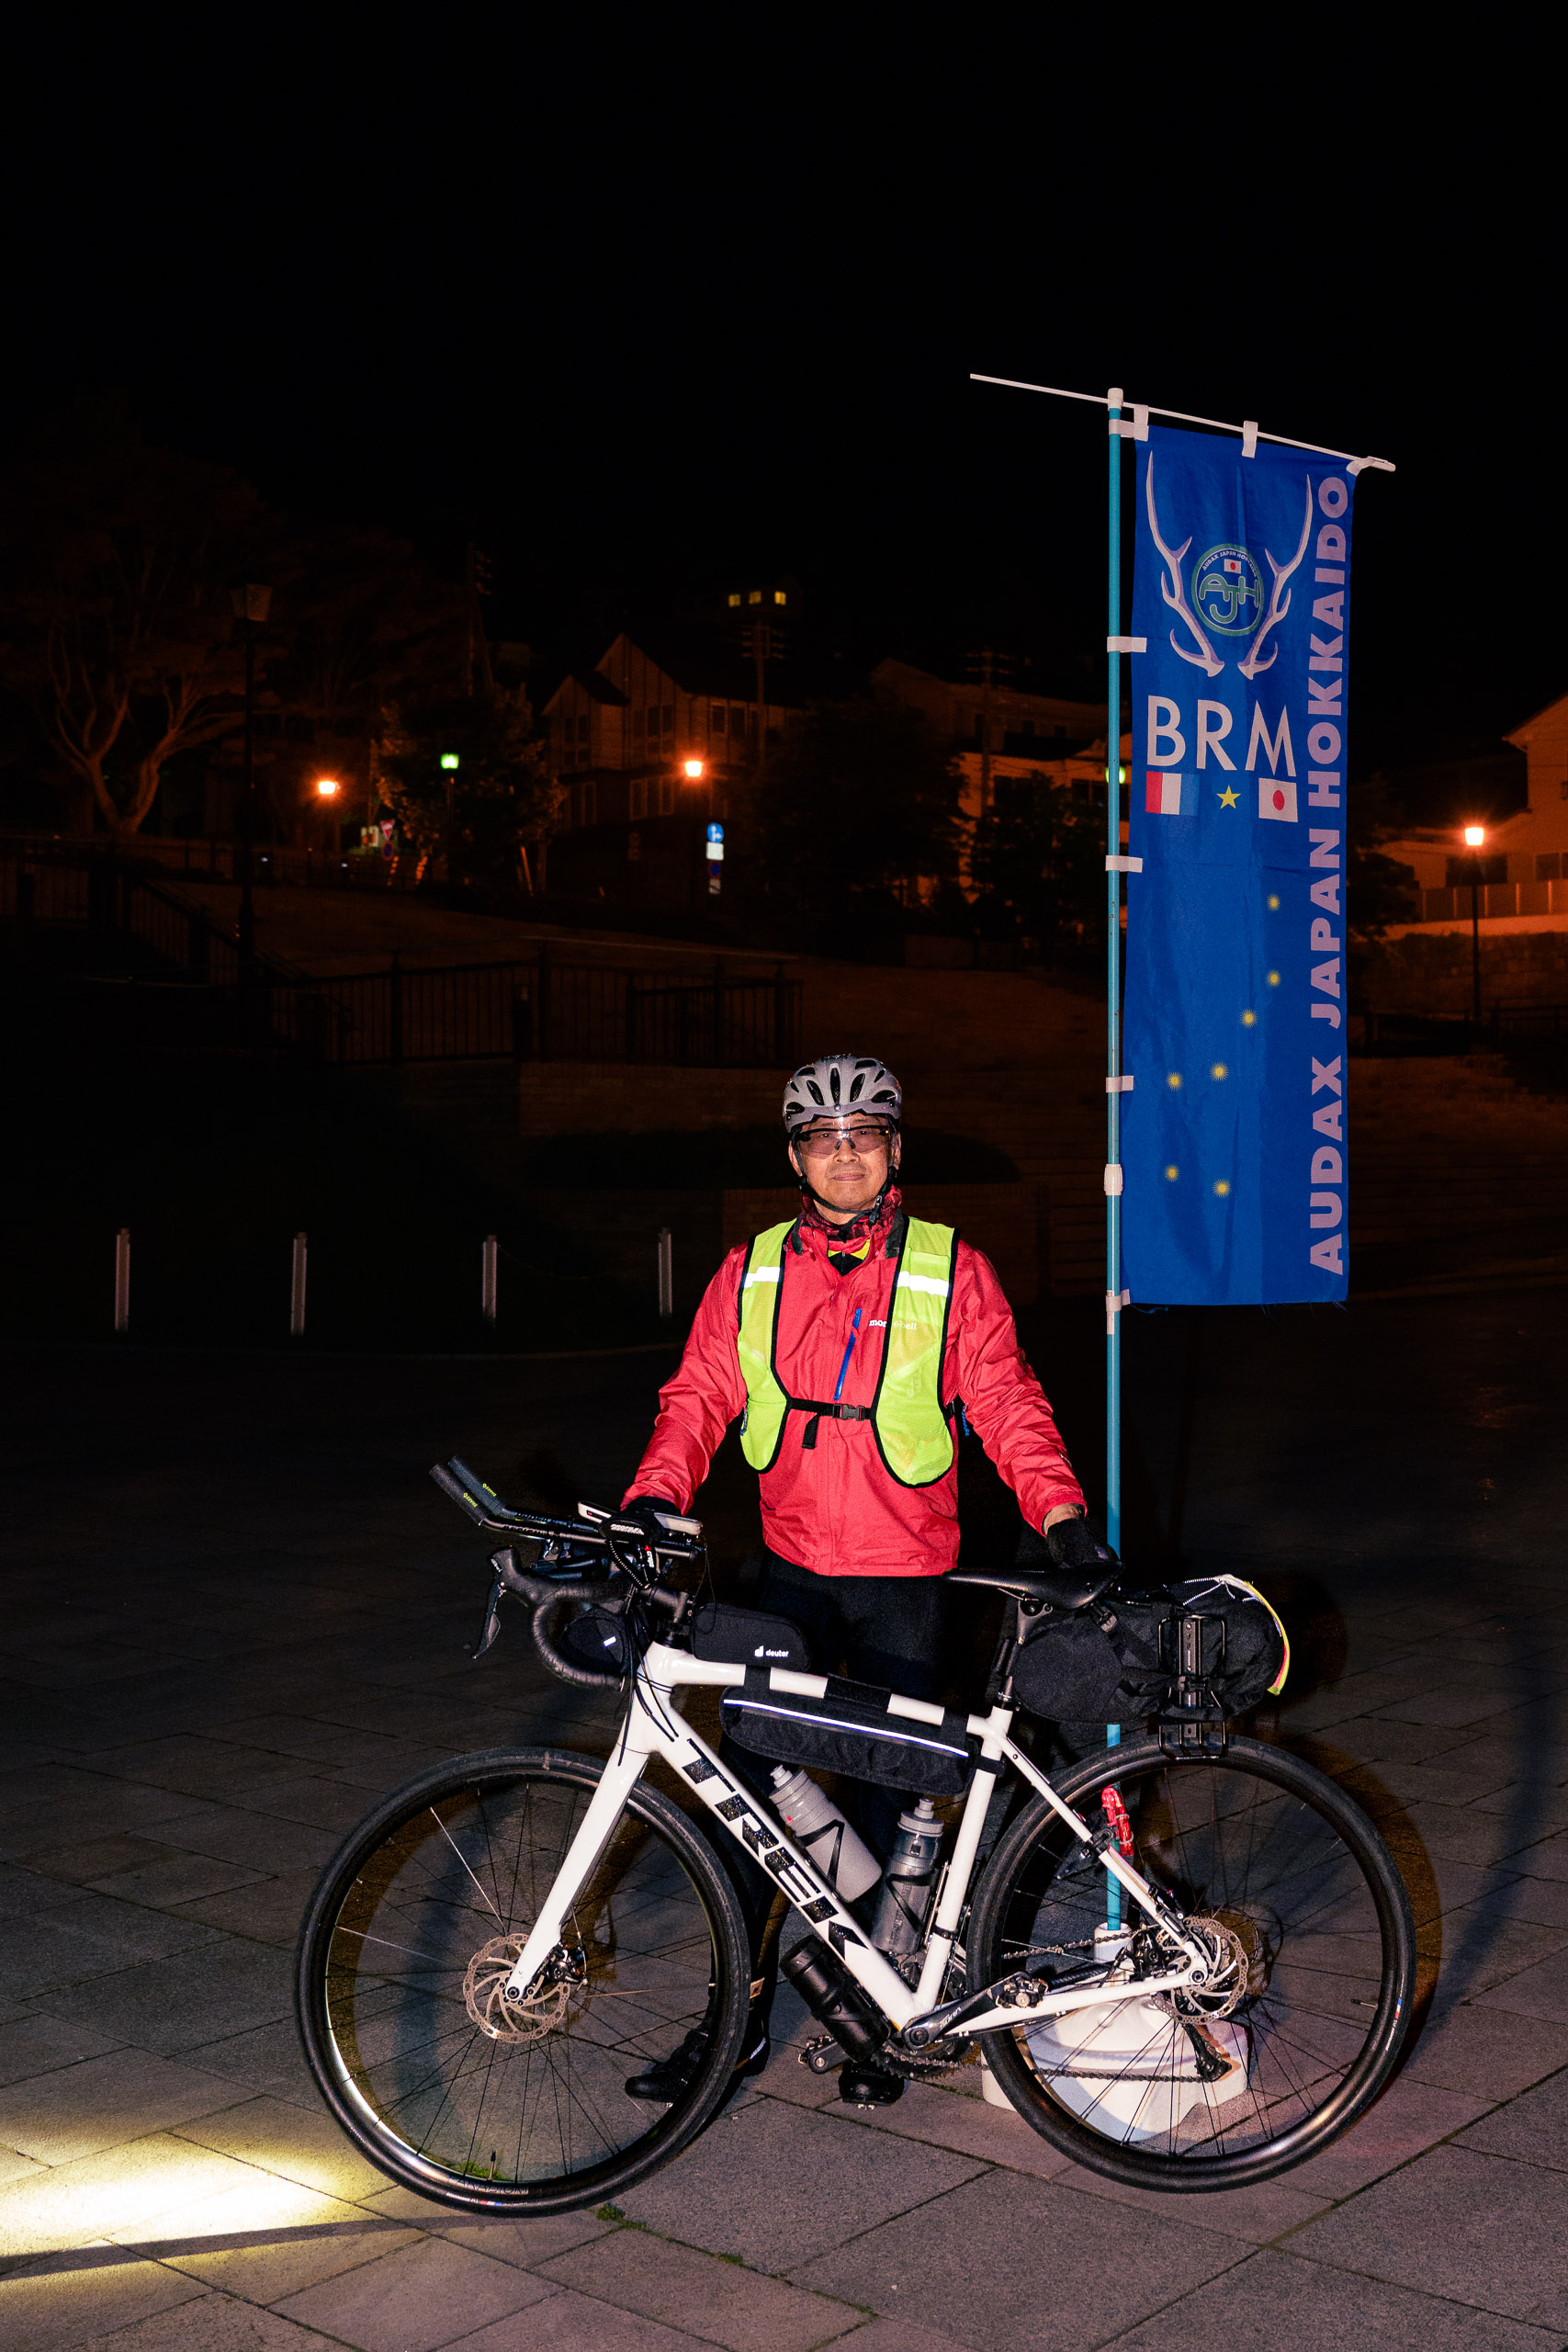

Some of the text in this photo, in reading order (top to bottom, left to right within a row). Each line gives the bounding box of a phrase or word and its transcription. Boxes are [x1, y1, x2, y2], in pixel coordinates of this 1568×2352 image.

[1202, 553, 1219, 571] AUDAX
[1146, 695, 1297, 777] BRM
[1306, 476, 1348, 1276] AUDAX JAPAN HOKKAIDO
[765, 1648, 790, 1657] deuter
[681, 1737, 869, 1962] TREK
